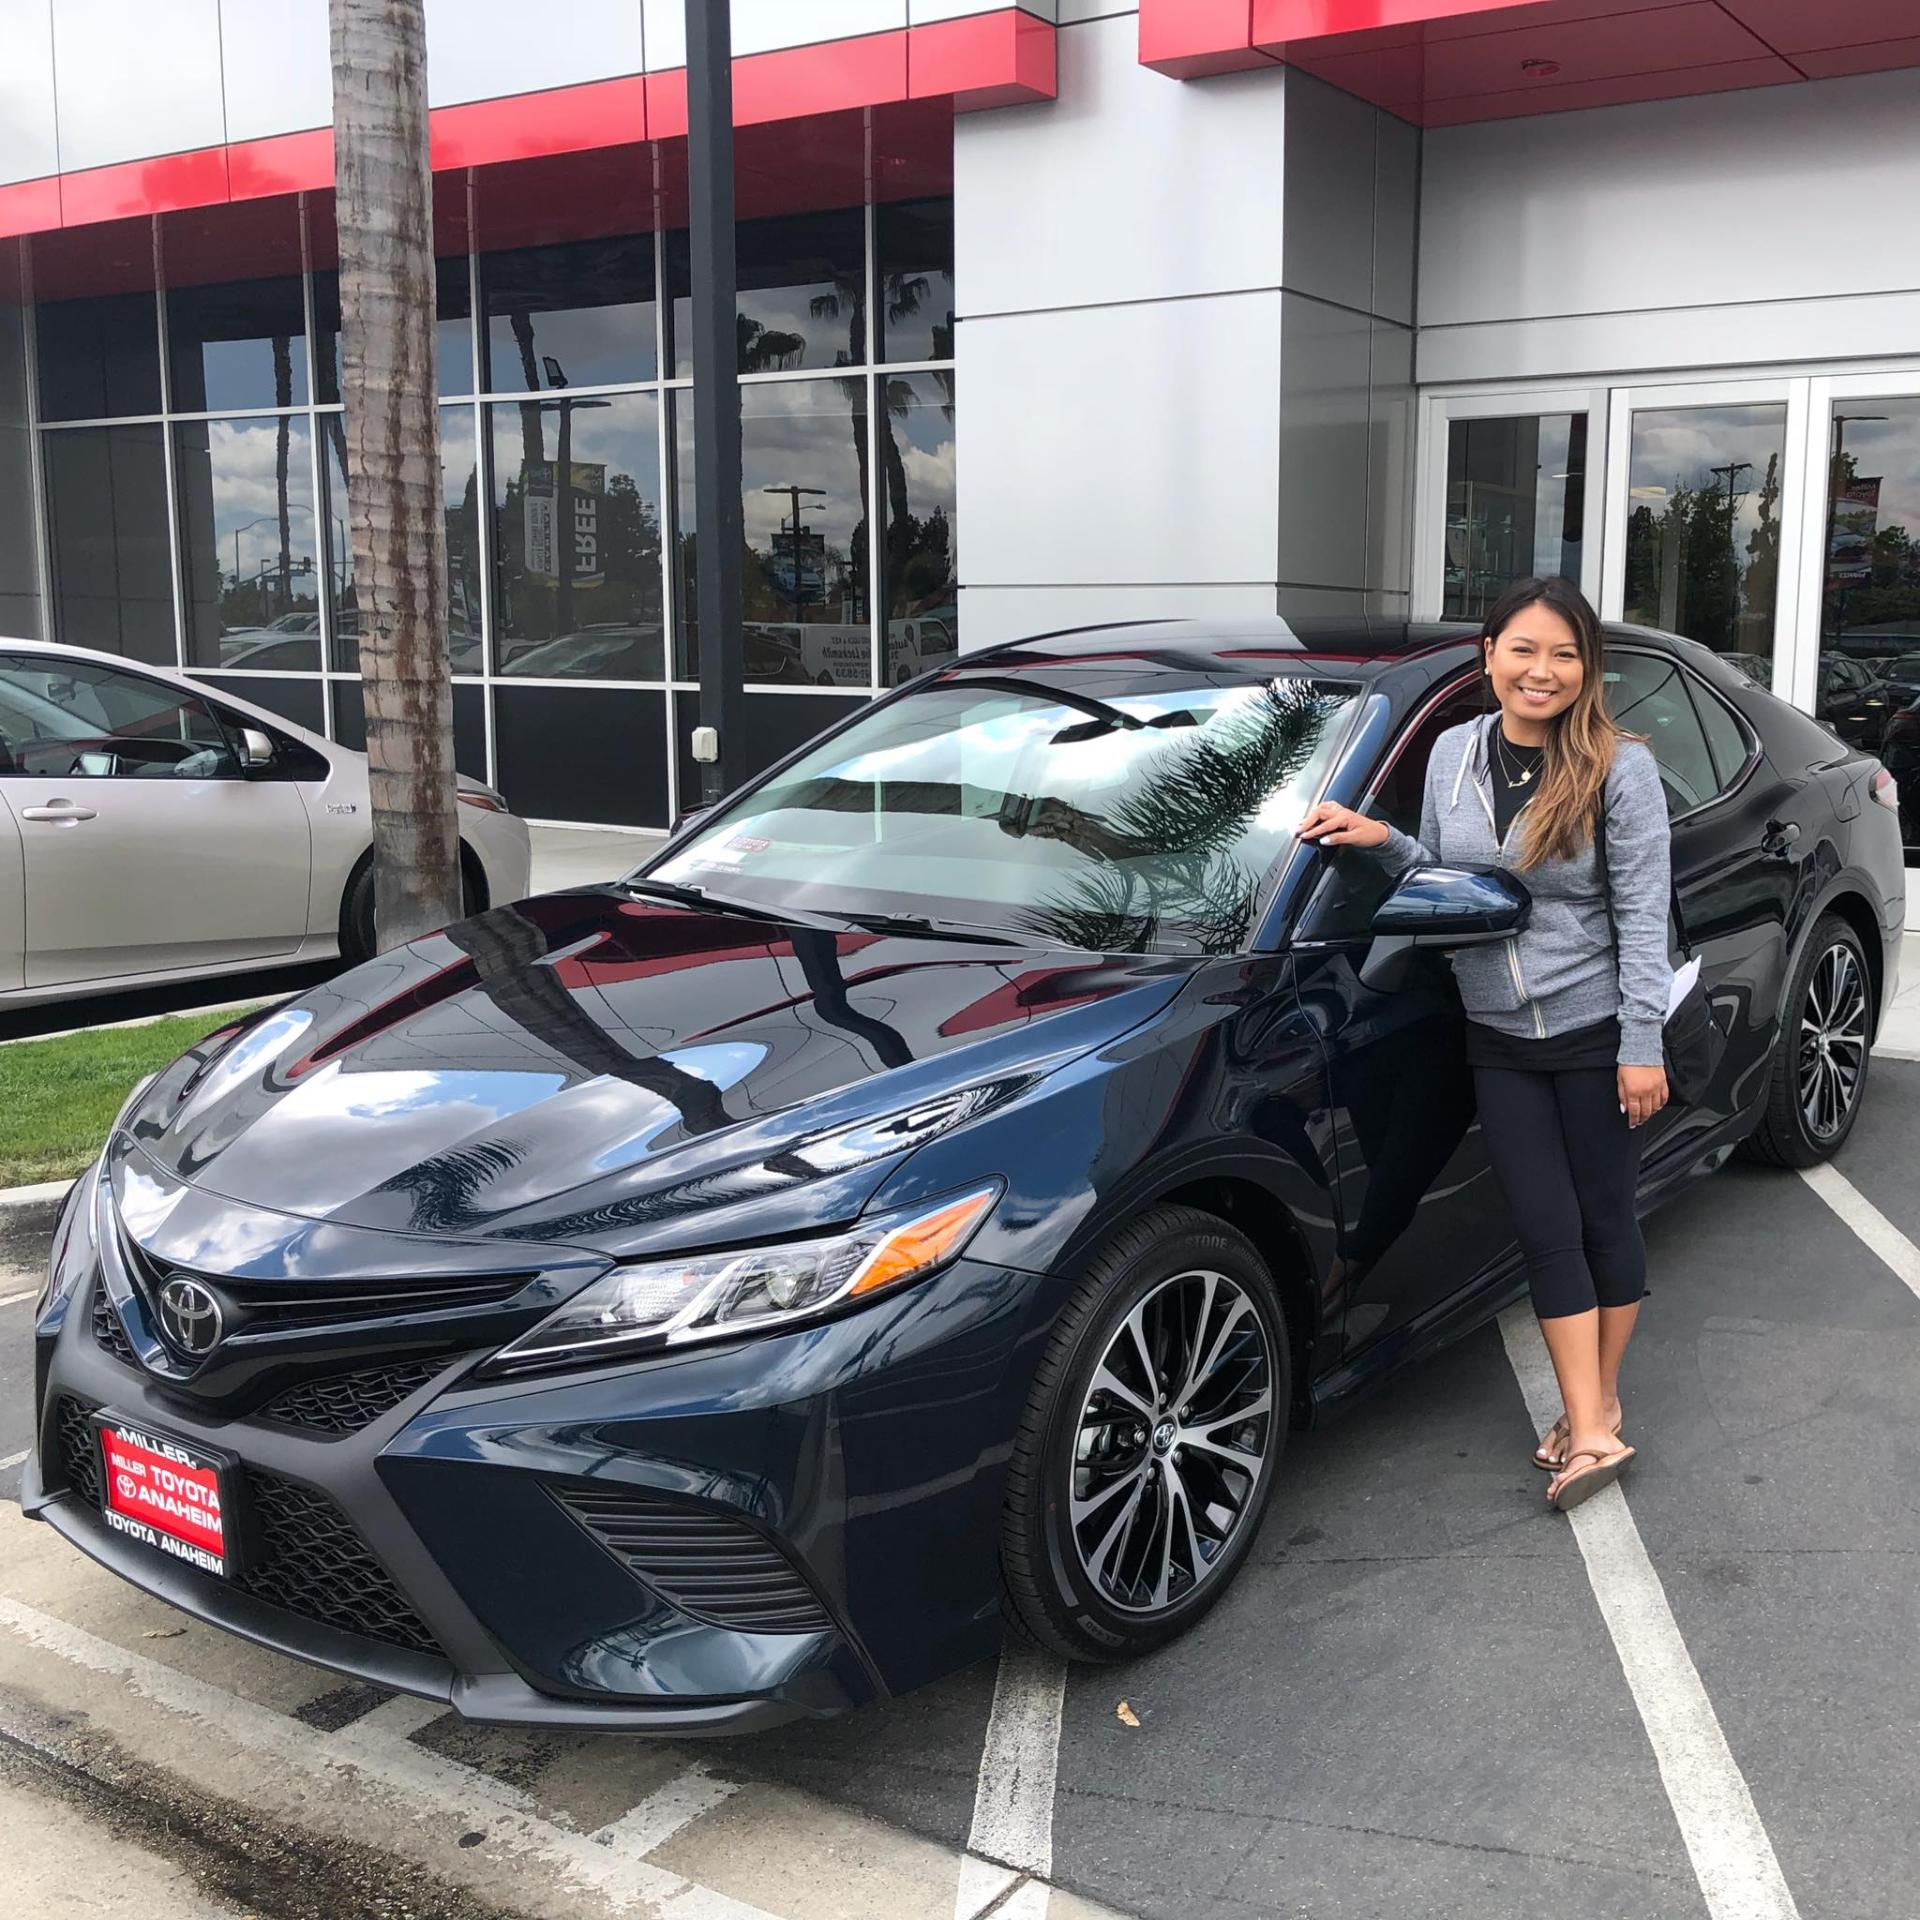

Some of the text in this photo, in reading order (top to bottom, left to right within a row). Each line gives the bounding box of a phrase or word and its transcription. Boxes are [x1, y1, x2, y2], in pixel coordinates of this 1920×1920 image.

[119, 1427, 191, 1467] MILLER
[111, 1452, 221, 1512] MILLER TOYOTA
[138, 1485, 223, 1535] ANAHEIM
[105, 1509, 224, 1576] TOYOTA ANAHEIM
